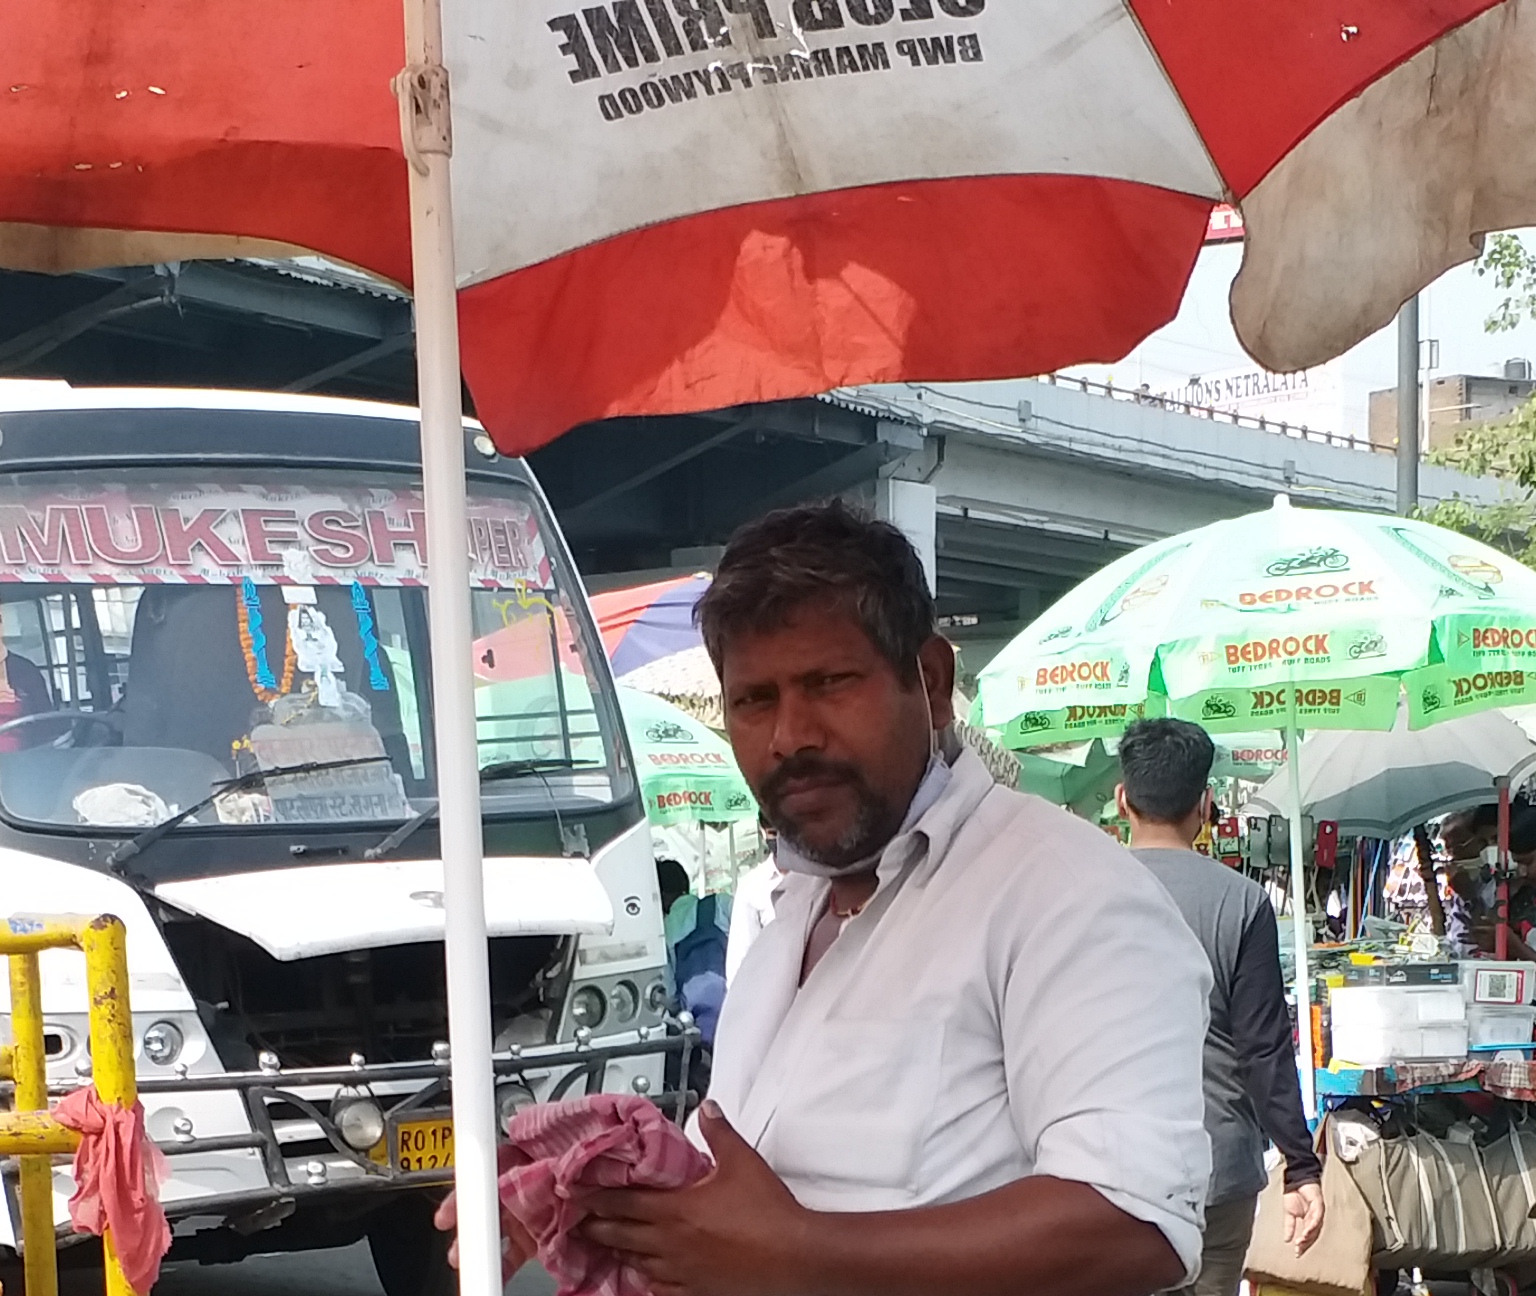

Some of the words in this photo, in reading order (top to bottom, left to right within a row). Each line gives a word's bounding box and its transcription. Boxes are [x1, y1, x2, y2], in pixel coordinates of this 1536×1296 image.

[465, 518, 528, 570] PER
[1238, 580, 1377, 606] BEDROCK
[1224, 633, 1330, 666] BEDROCK
[1035, 661, 1111, 687] BEDROCK
[648, 752, 728, 766] BEDROCK
[1231, 749, 1288, 761] BEDROCK
